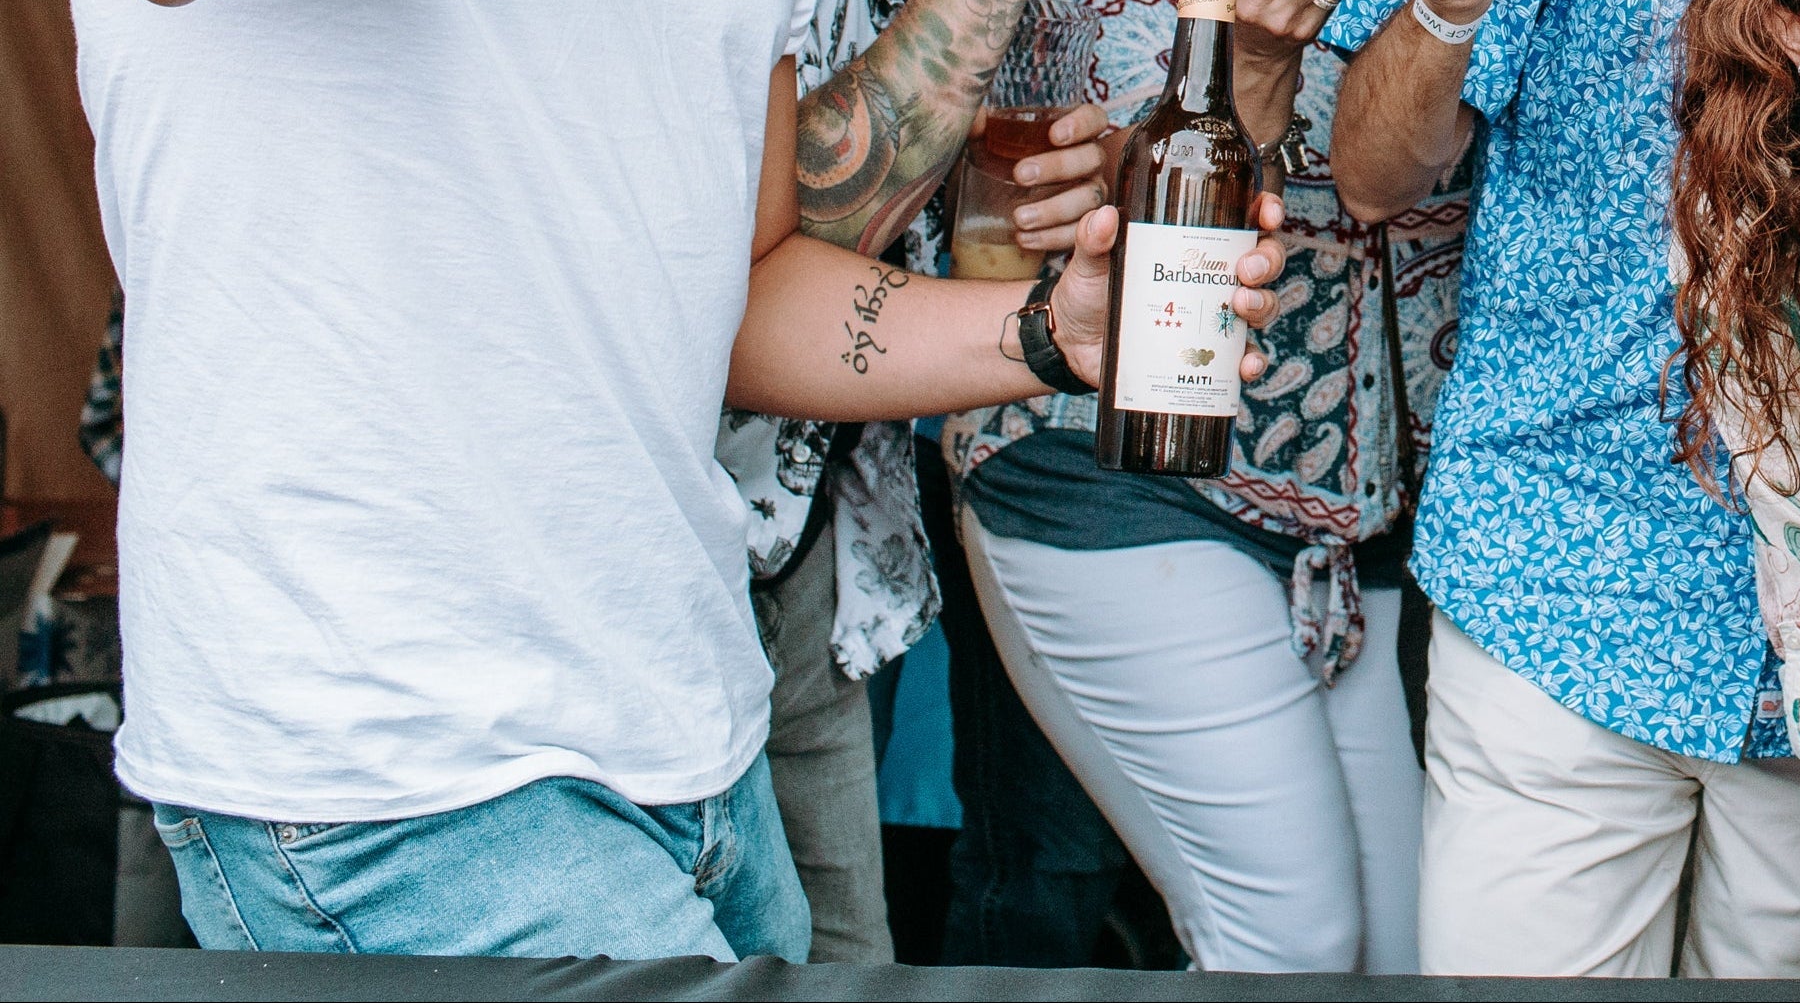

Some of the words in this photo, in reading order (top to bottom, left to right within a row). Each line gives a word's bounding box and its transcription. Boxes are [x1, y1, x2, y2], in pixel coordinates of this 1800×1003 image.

[1197, 122, 1227, 133] 1862
[1181, 248, 1230, 273] Rhum
[1164, 301, 1174, 317] 4
[1177, 374, 1212, 386] HAITI
